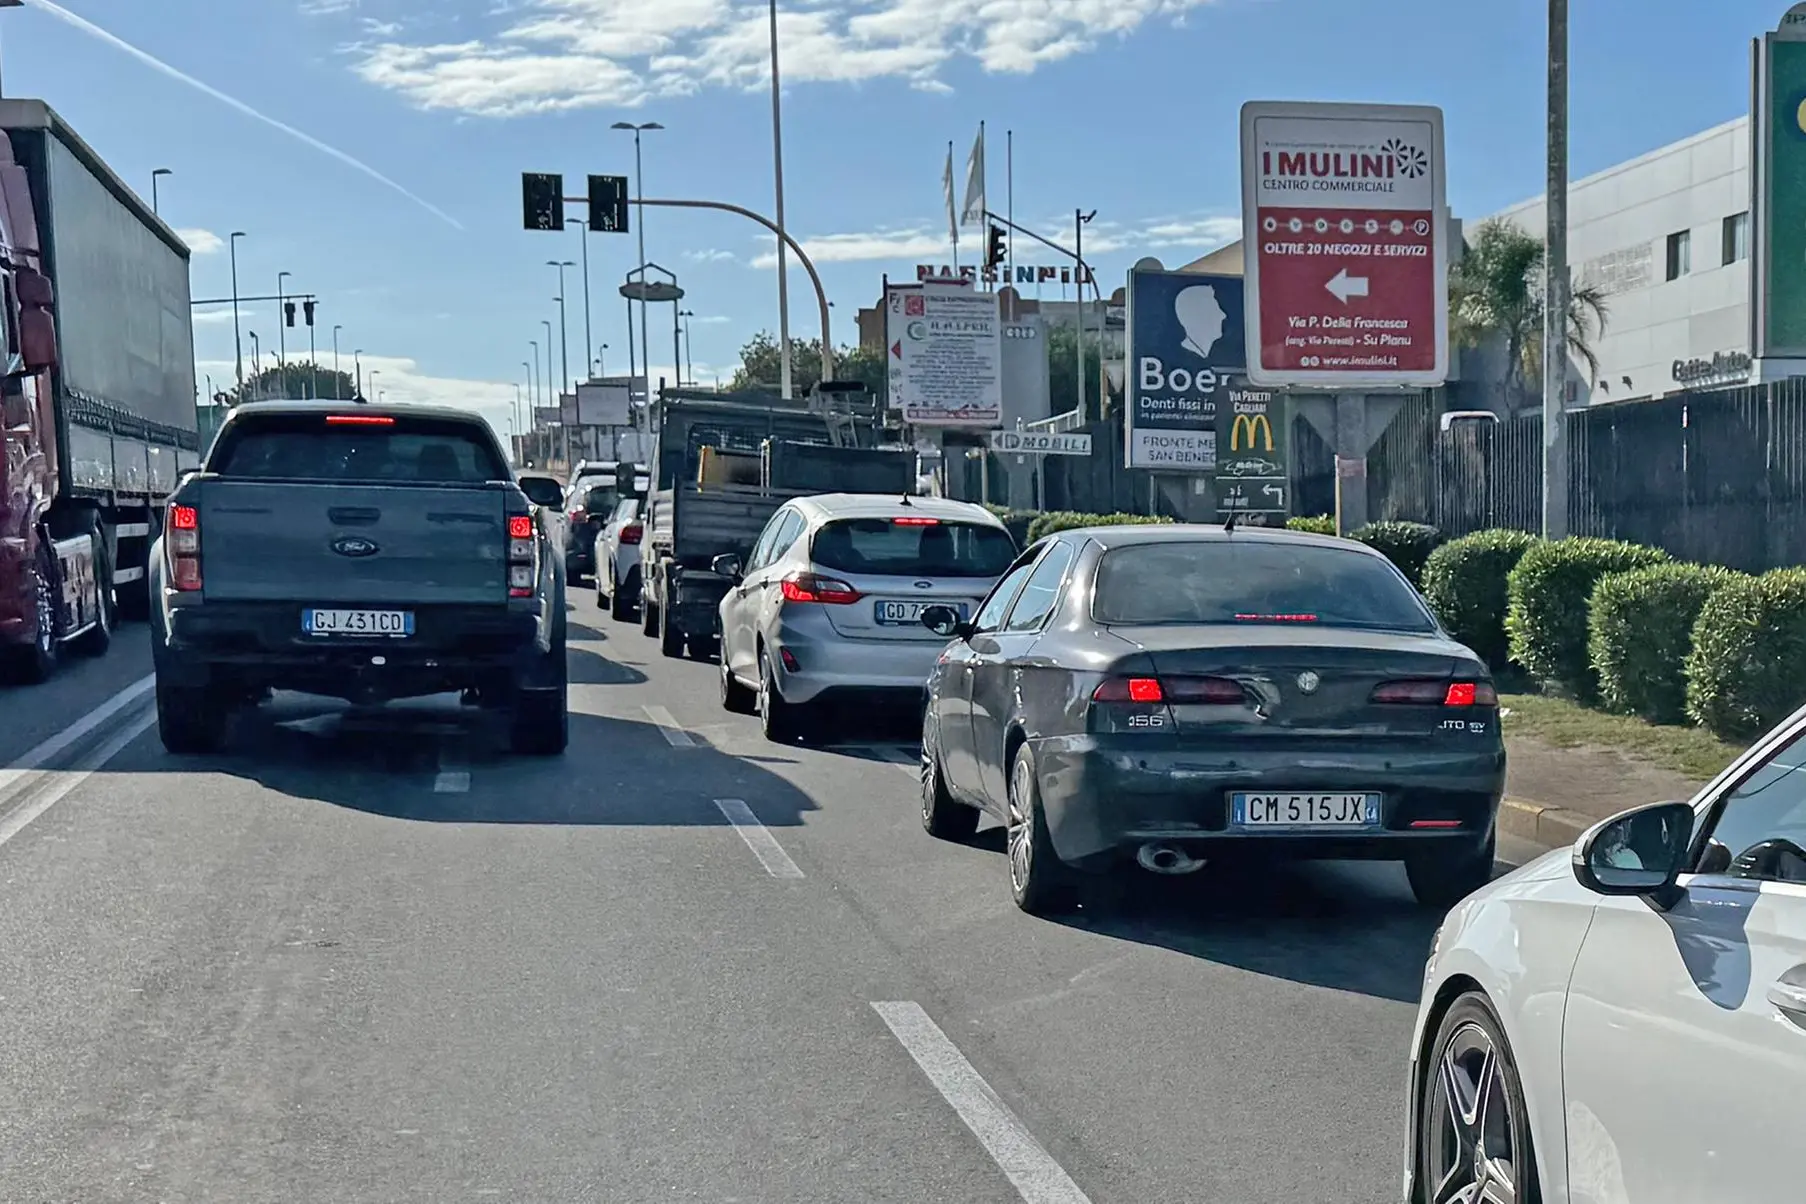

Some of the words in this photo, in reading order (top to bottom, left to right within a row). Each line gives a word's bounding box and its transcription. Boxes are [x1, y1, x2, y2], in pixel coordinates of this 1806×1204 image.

[1263, 151, 1271, 176] I
[1278, 152, 1395, 179] MULINI
[1263, 179, 1309, 191] CENTRO
[1312, 180, 1395, 192] COMMERCIALE
[1264, 242, 1304, 254] OLTRE
[1306, 243, 1320, 255] 20
[1323, 244, 1371, 255] NEGOZI
[1373, 245, 1382, 255] E
[1383, 245, 1427, 256] SERVIZI
[1288, 316, 1306, 328] Via
[1308, 316, 1320, 328] P.
[1322, 316, 1351, 328] Della
[1363, 334, 1378, 345] Su
[1379, 334, 1412, 345] Planu
[1322, 356, 1397, 366] www.imulini.it
[1141, 396, 1176, 409] Denti
[1178, 397, 1201, 410] fissi
[1203, 398, 1216, 411] in
[1143, 436, 1195, 448] FRONTE
[1149, 450, 1172, 460] SAN
[886, 603, 905, 619] GD
[315, 612, 336, 629] GJ
[345, 612, 401, 630] 431CD
[1250, 797, 1278, 822] CM
[1288, 796, 1362, 821] 515JX
